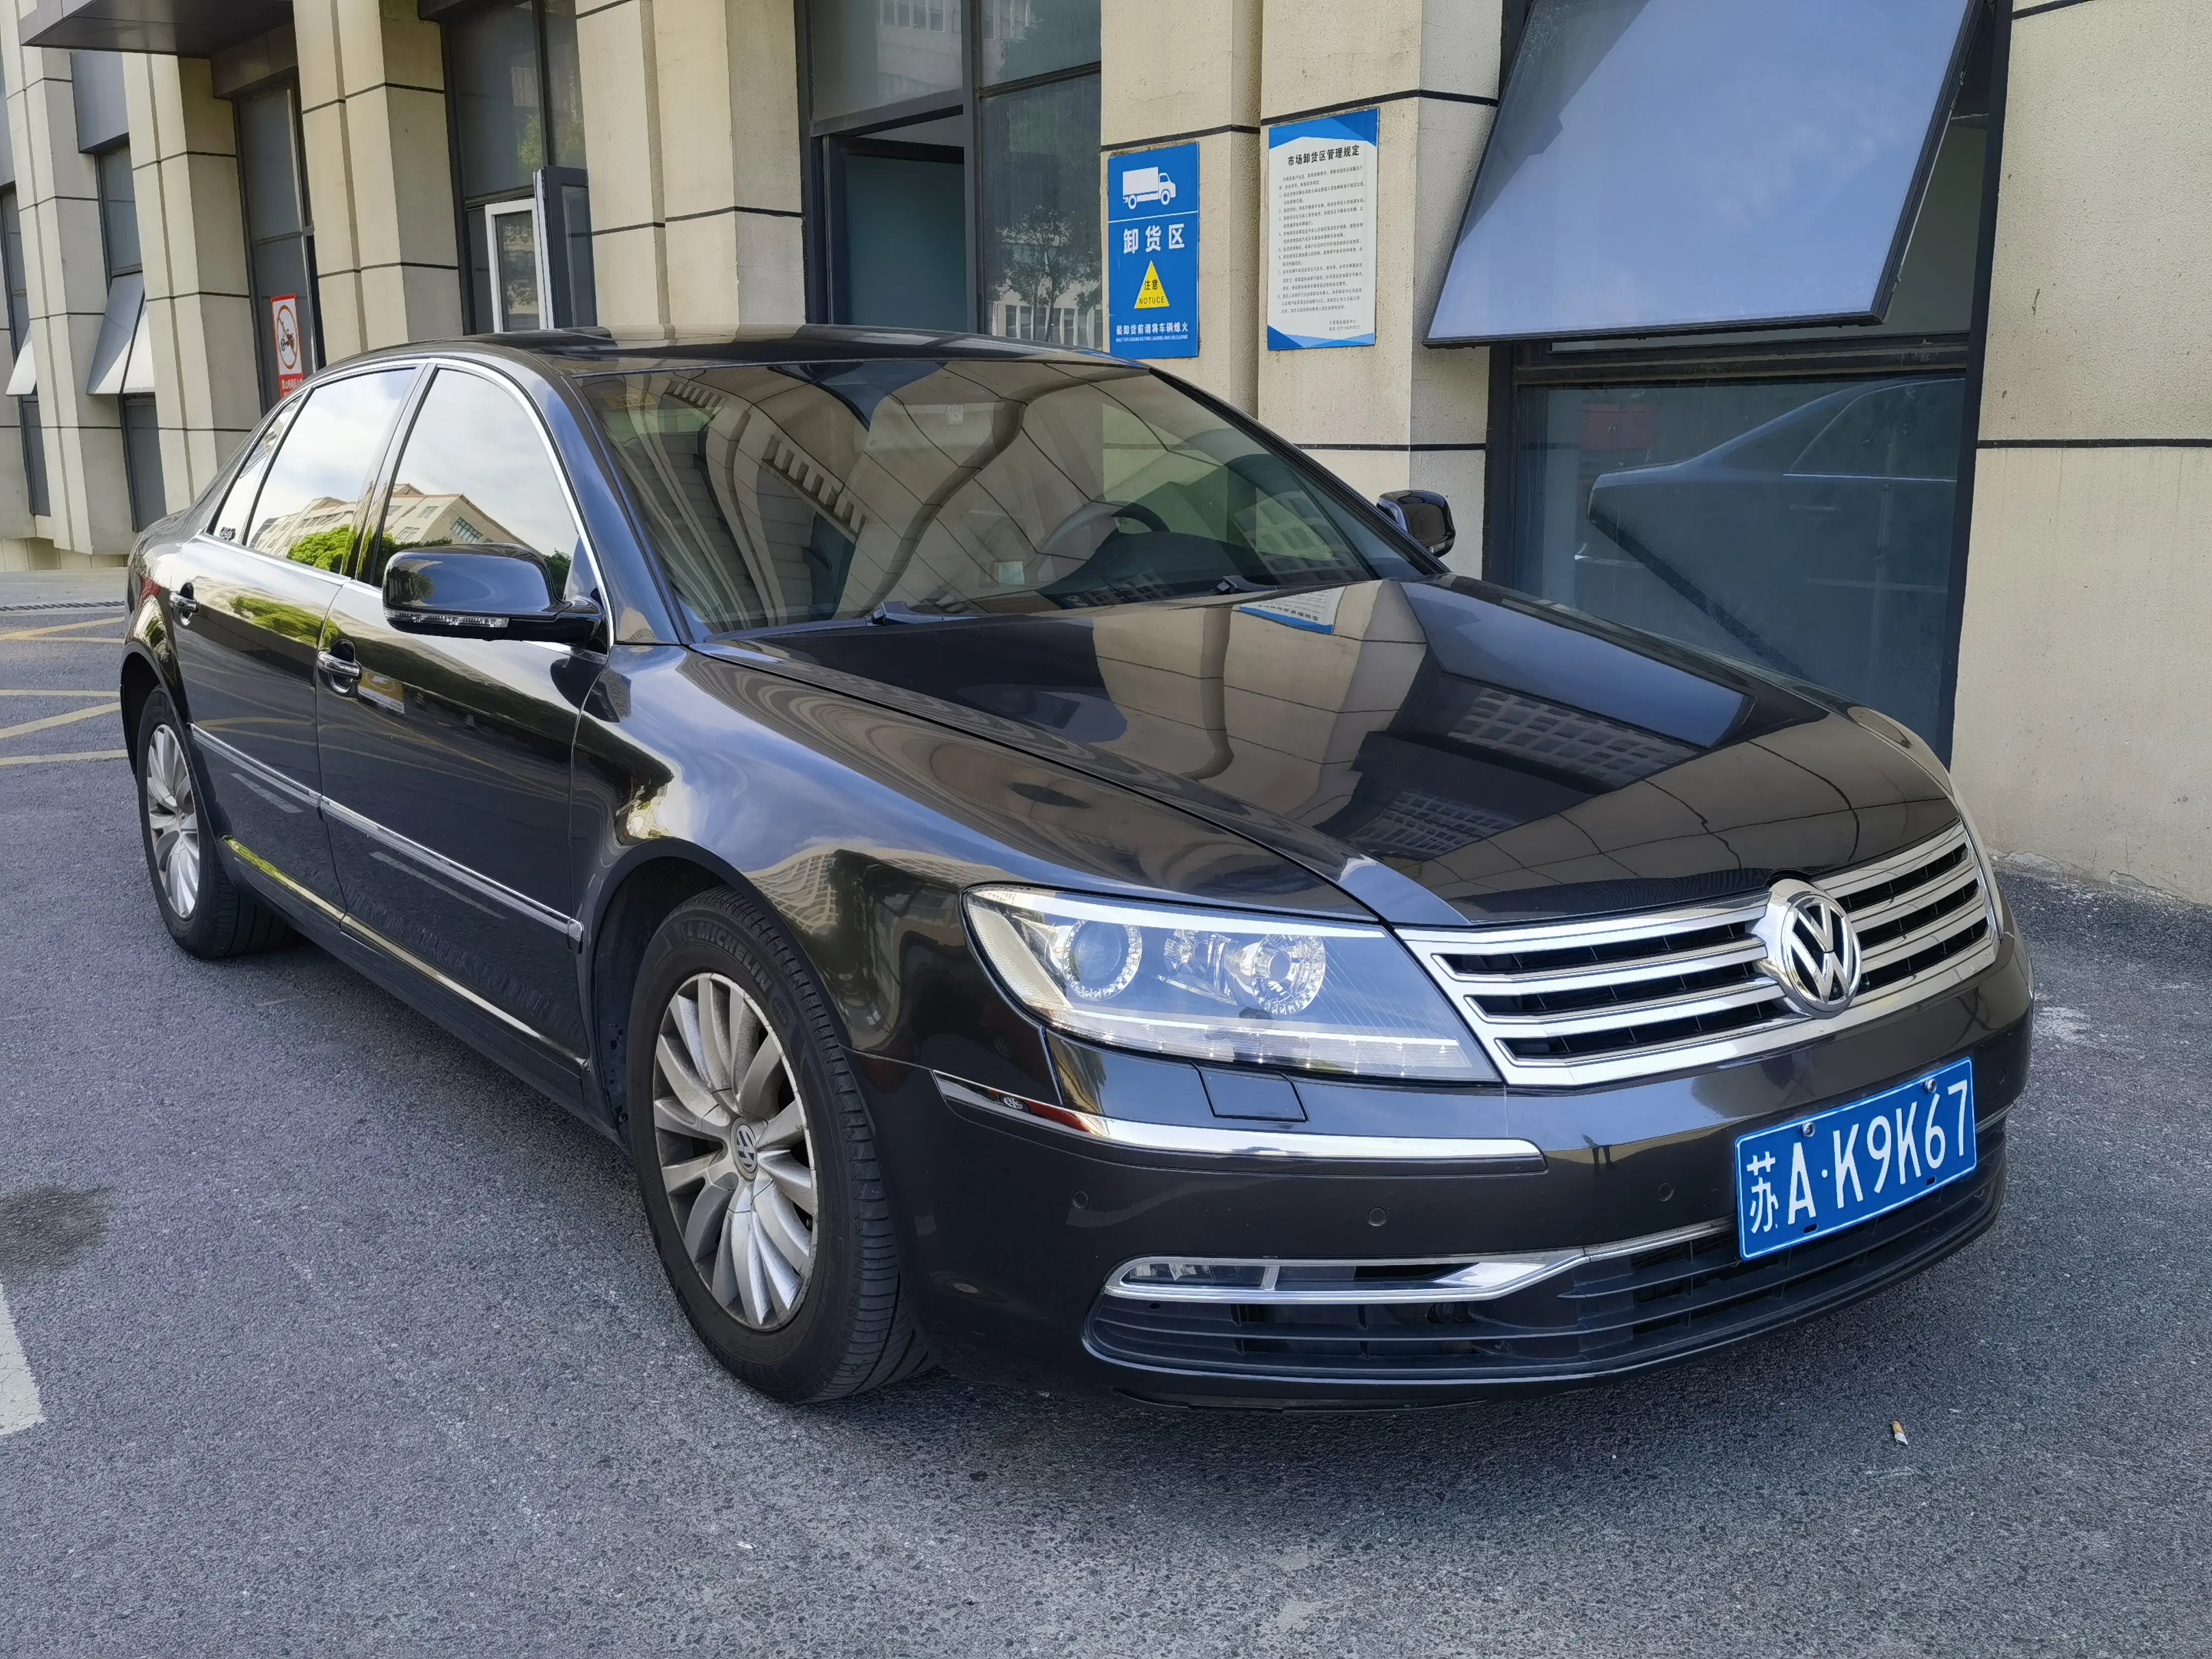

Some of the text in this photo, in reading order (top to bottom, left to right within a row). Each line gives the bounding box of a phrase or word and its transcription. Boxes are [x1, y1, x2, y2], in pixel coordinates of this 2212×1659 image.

[1288, 144, 1359, 166] 市场卸货区管理规定
[1123, 223, 1185, 254] 卸货区
[1144, 279, 1158, 291] 注意
[1139, 296, 1164, 305] NOTUCE
[1116, 321, 1188, 335] 装卸货前请将车辆熄火
[697, 921, 773, 993] MICHELIN
